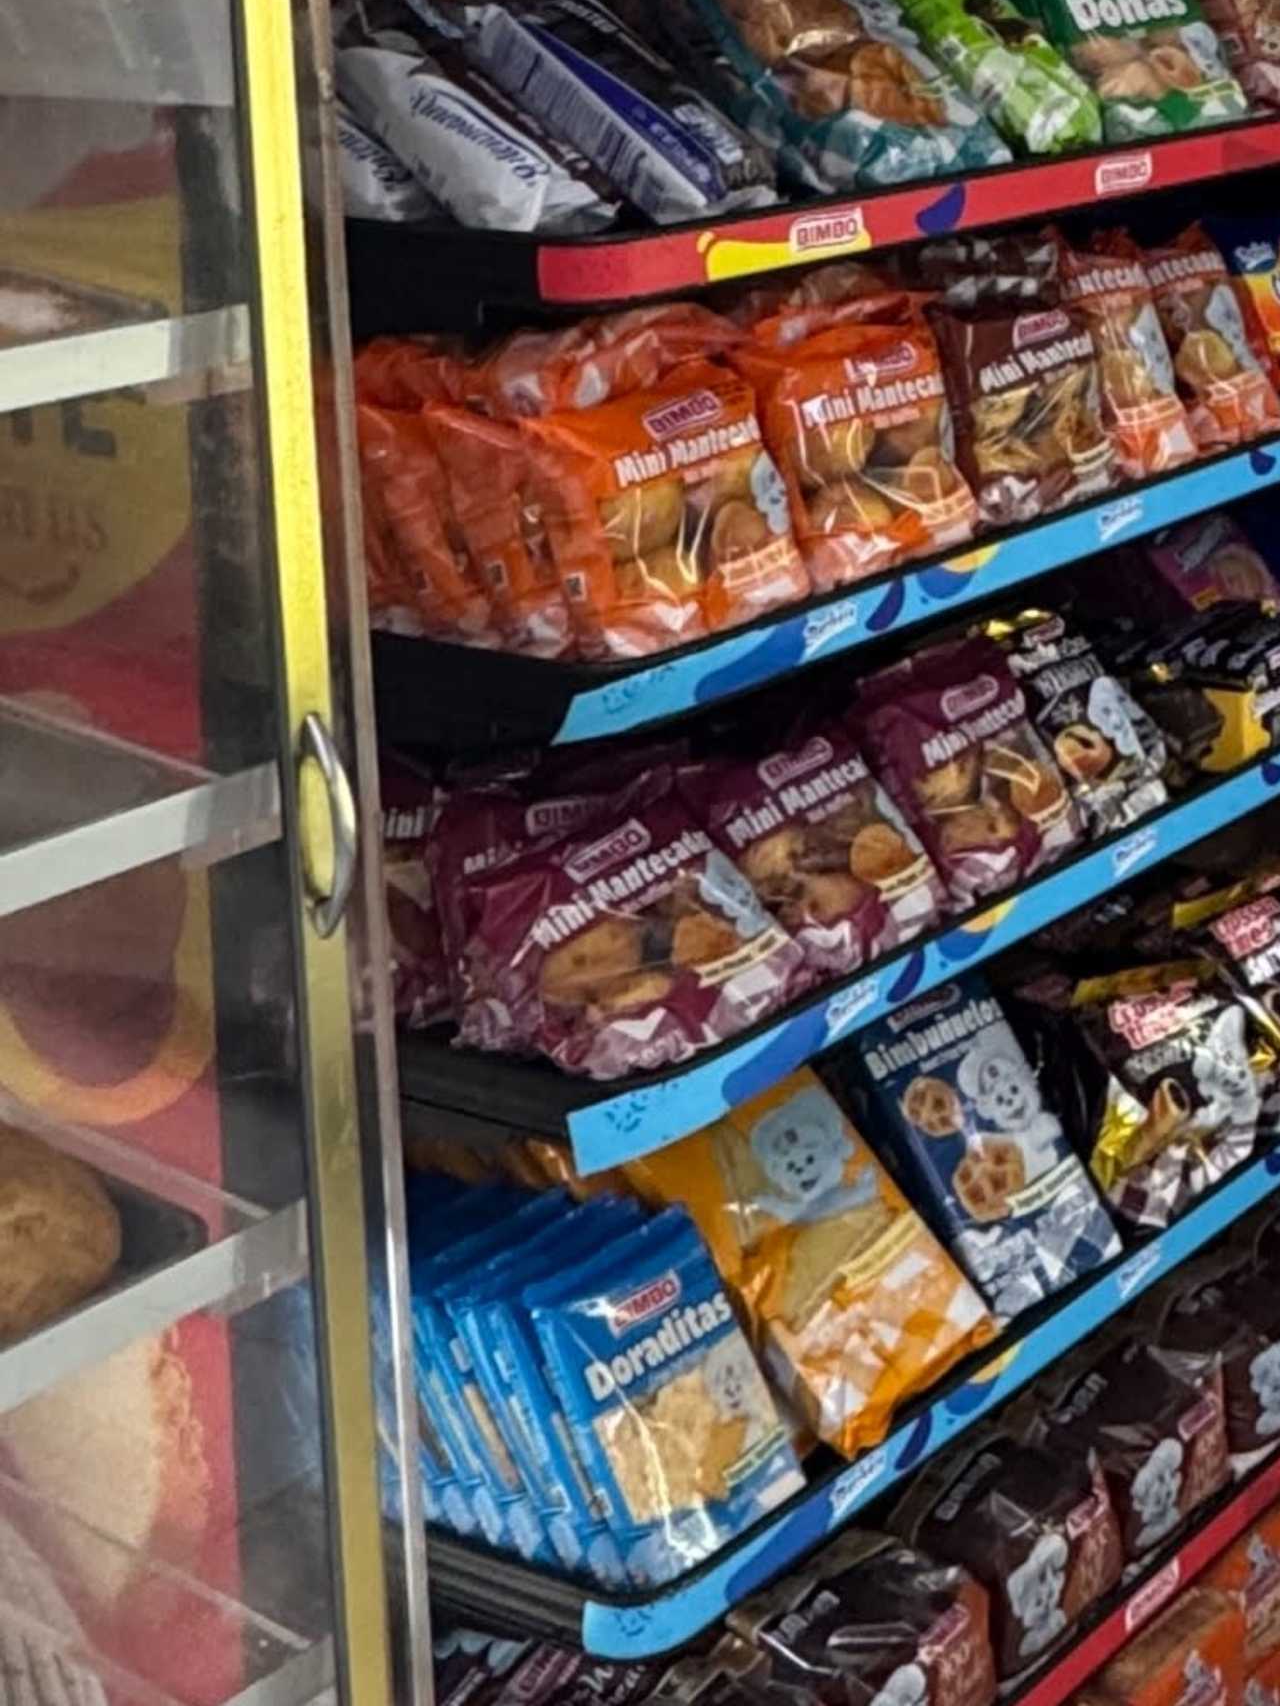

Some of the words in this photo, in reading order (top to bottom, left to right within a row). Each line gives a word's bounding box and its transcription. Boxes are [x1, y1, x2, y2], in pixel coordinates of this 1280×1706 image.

[797, 219, 857, 247] BIMBO
[978, 353, 1021, 393] Mini
[649, 396, 719, 435] BIMBO
[613, 446, 669, 486] Mini
[725, 794, 784, 847] Mini
[583, 1292, 732, 1402] Doraditas
